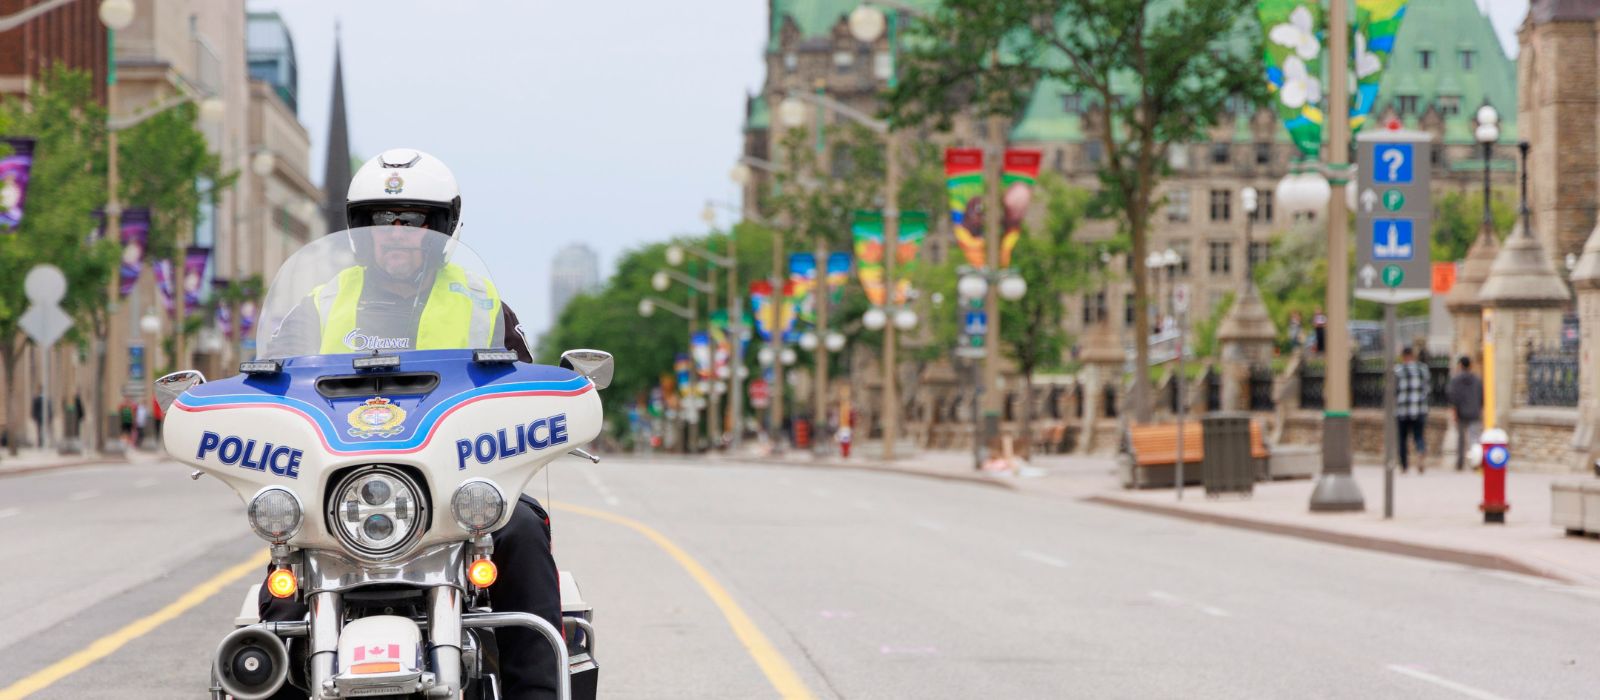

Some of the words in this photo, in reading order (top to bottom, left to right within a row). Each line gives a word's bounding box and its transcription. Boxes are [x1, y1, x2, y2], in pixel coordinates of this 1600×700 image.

[1388, 190, 1399, 210] P
[1388, 266, 1399, 286] P
[343, 328, 409, 351] Ottawa
[456, 413, 568, 470] POLICE
[196, 430, 304, 479] POLICE
